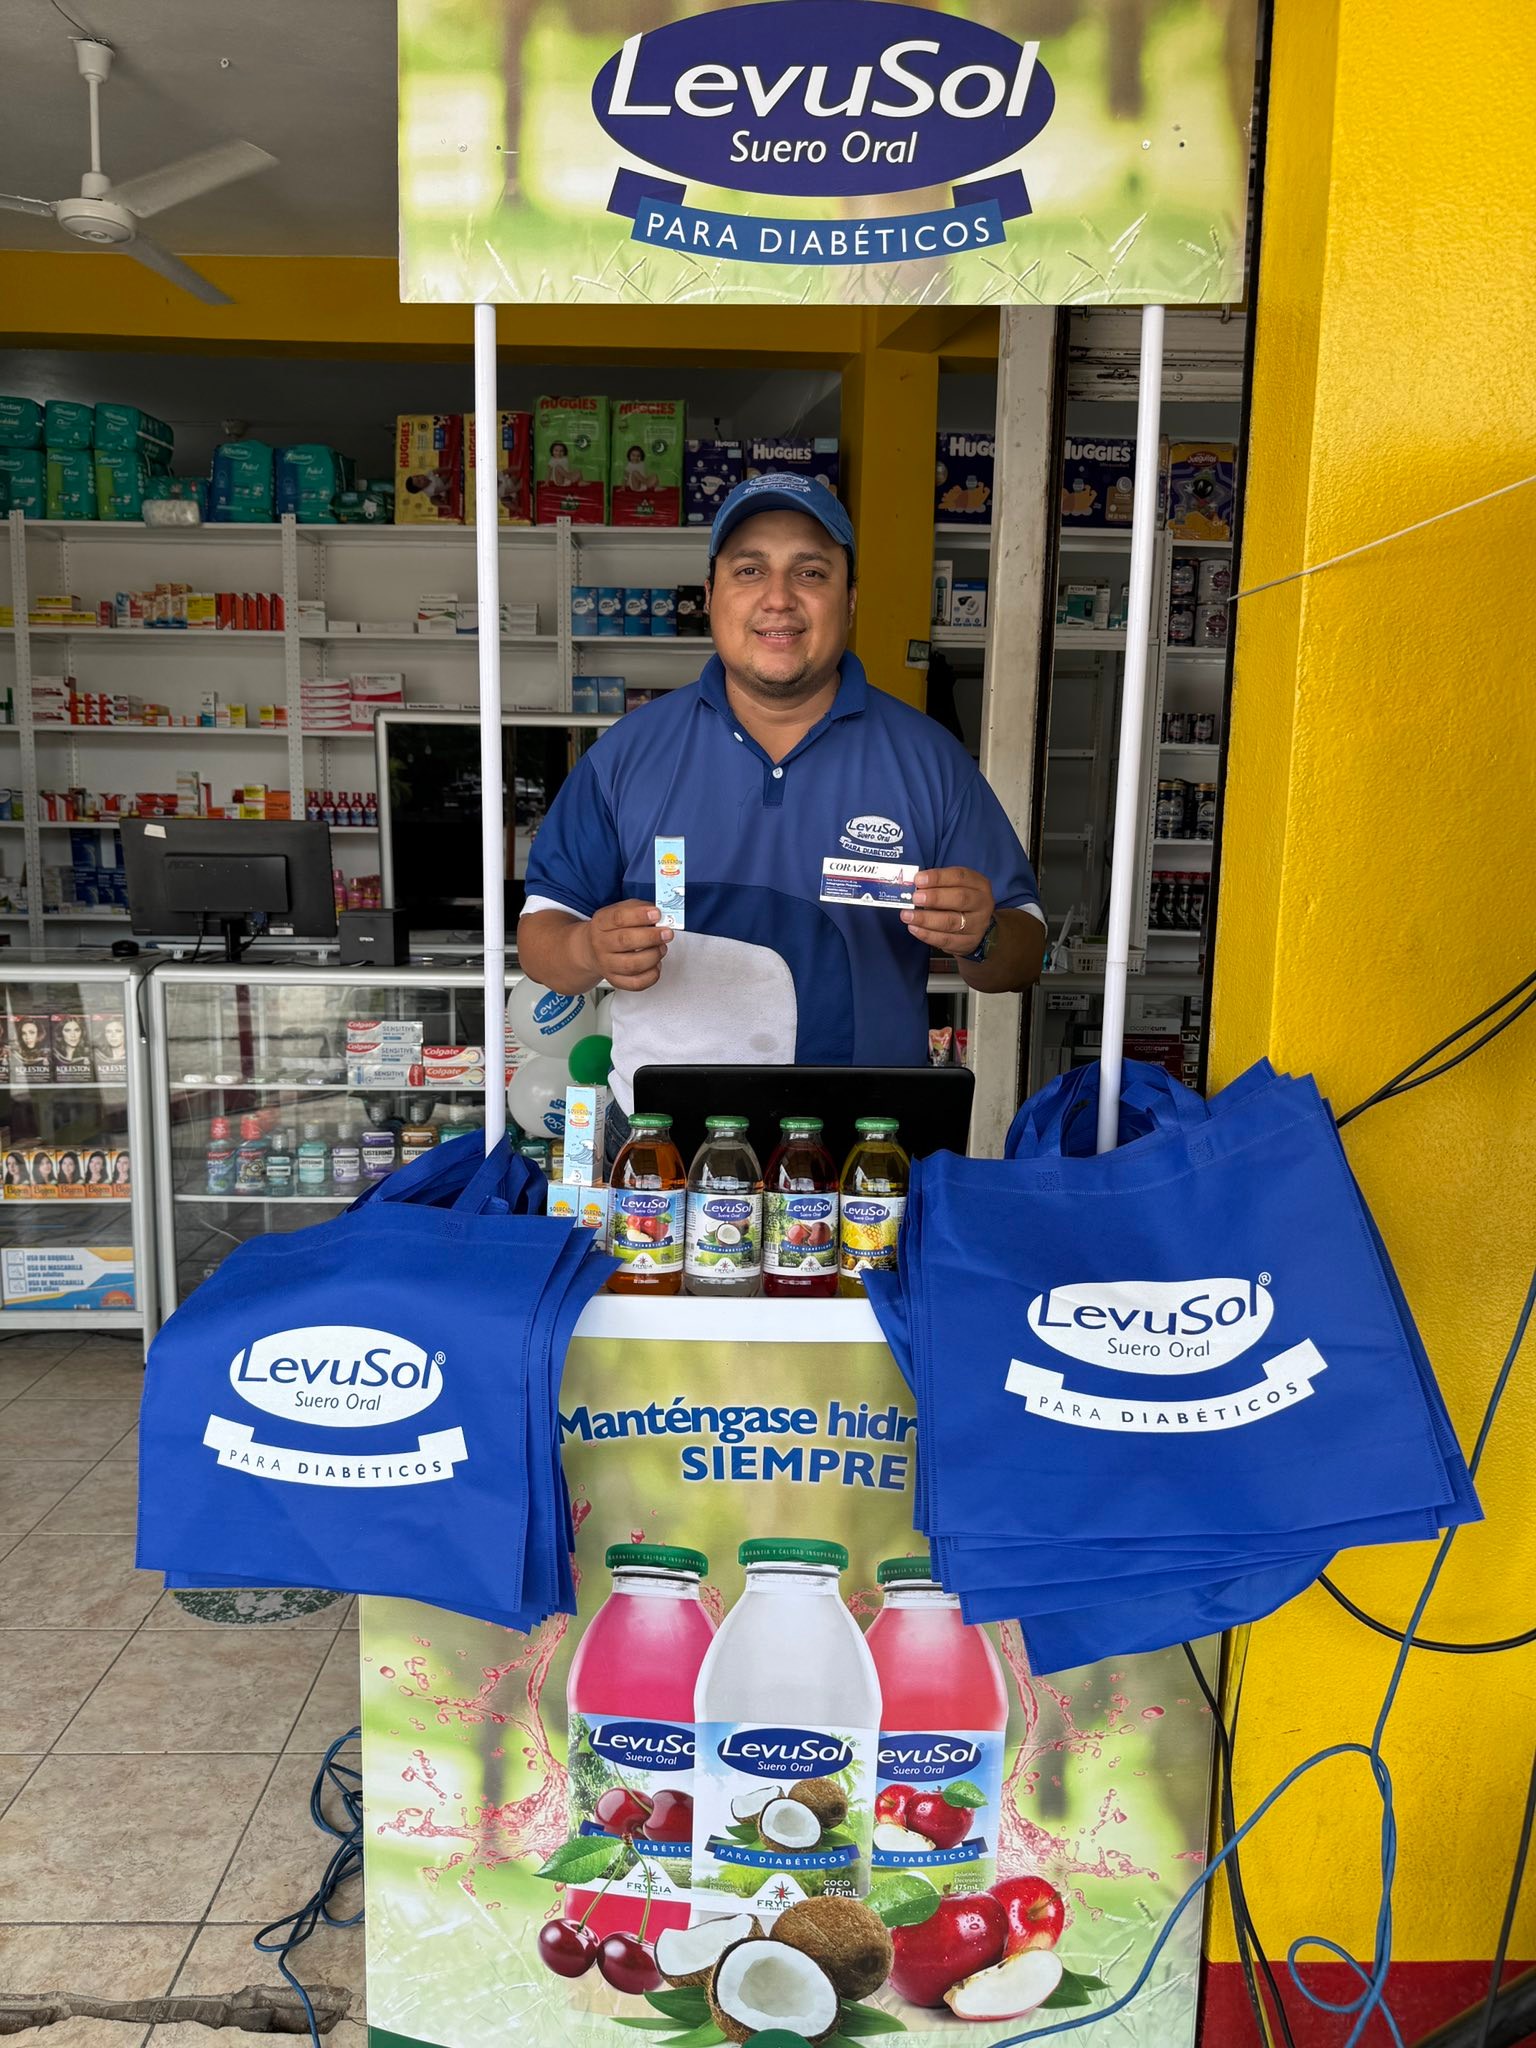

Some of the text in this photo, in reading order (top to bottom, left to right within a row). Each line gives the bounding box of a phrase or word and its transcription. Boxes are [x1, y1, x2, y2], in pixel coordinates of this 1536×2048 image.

[607, 31, 1040, 119] LevuSol
[729, 130, 917, 164] Suero Oral
[645, 211, 992, 258] PARA DIABÉTICOS
[619, 402, 676, 415] HUGGIES
[399, 421, 410, 468] HUGGIES
[753, 444, 812, 460] HUGGIES
[848, 819, 902, 838] LevuSol
[877, 834, 891, 842] Oral
[844, 843, 862, 852] PARA
[347, 1021, 378, 1029] Colgate
[382, 1025, 416, 1033] SENSITIVE
[346, 1043, 376, 1051] Colgate
[381, 1047, 415, 1055] SENSITIVE
[423, 1046, 461, 1057] Colgate
[425, 1067, 462, 1077] Colgate
[621, 1197, 670, 1209] LevuSol
[704, 1202, 752, 1213] LevuSol
[786, 1201, 831, 1212] LevuSol
[844, 1203, 889, 1217] LevuSol
[1037, 1280, 1258, 1336] LevuSol
[1107, 1337, 1211, 1359] Suero Oral
[238, 1347, 433, 1390] LevuSol
[294, 1390, 382, 1412] Suero Oral
[1039, 1381, 1298, 1425] PARA DIABÉTICOS
[558, 1397, 818, 1444] Manténgase
[229, 1449, 442, 1480] PARA DIABÉTICOS
[681, 1445, 909, 1491] SIEMPRE
[722, 1734, 848, 1761] LevuSol
[625, 1752, 678, 1765] Suero Oral
[758, 1761, 814, 1773] Suero Oral
[893, 1765, 946, 1775] Suero Oral
[719, 1849, 847, 1866] PARA DIABÉTICOS
[892, 1849, 975, 1863] DIABÉTICOS
[626, 1882, 673, 1894] FRYCIA
[823, 1879, 851, 1887] COCO
[822, 1888, 860, 1897] 475mL
